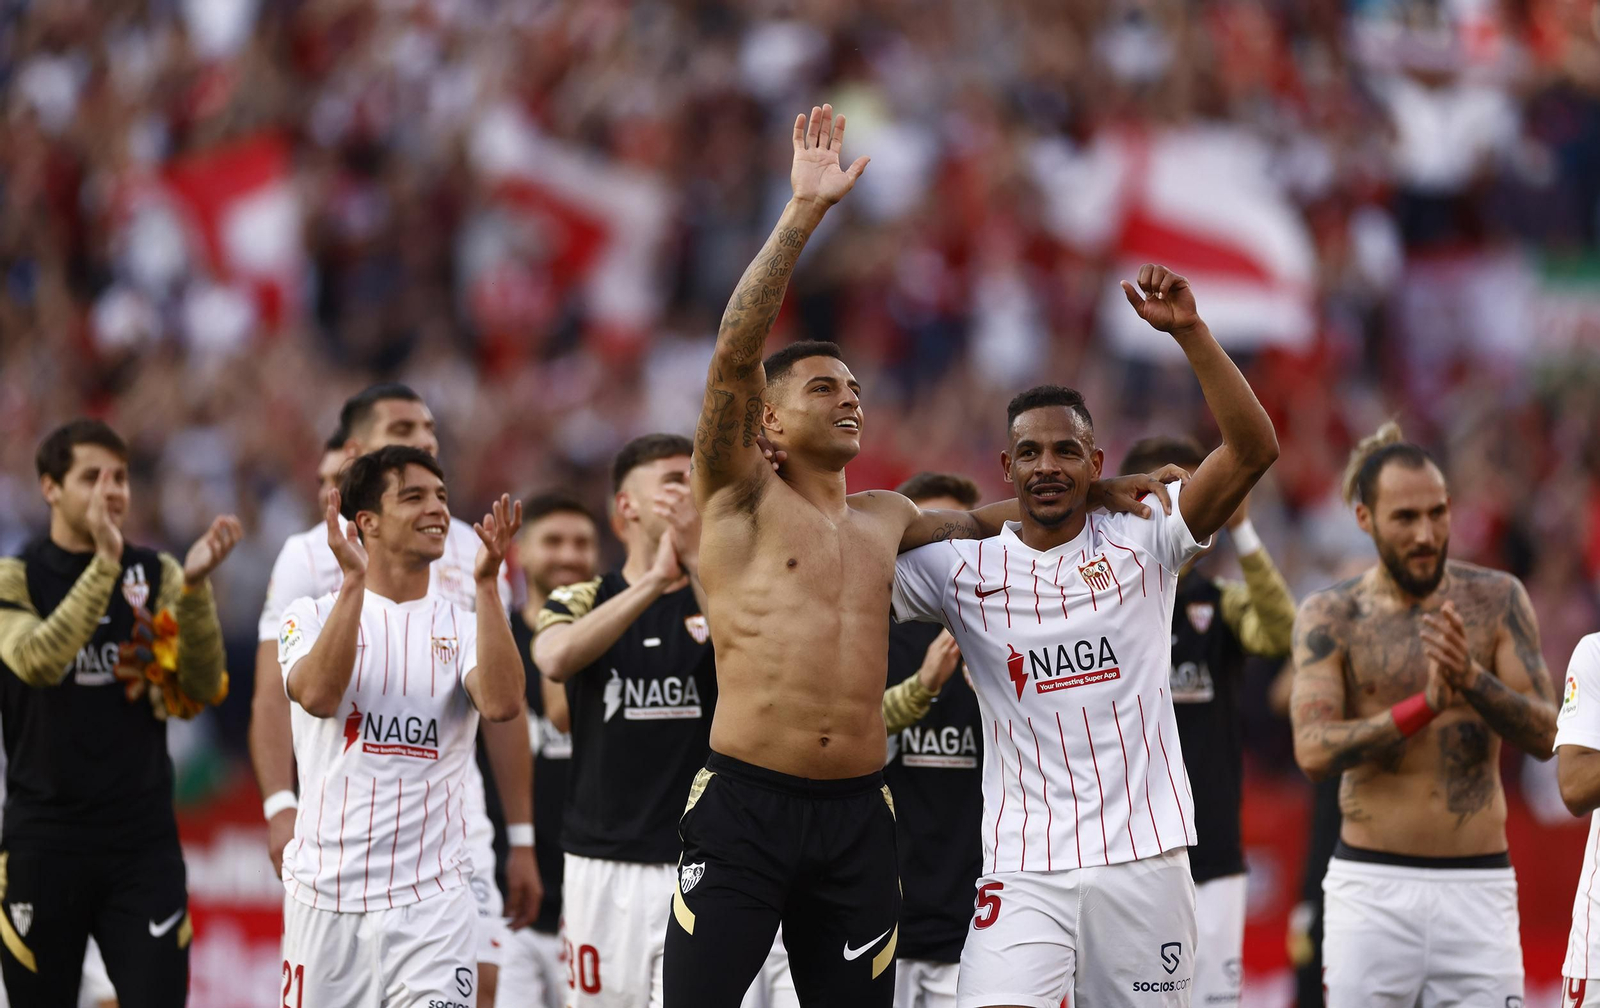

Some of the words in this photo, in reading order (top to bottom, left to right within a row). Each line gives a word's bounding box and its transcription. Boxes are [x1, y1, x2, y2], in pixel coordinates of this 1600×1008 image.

[76, 642, 119, 673] NAG
[1028, 636, 1118, 680] NAGA
[624, 675, 700, 707] NAGA
[1055, 678, 1085, 688] Investing
[1085, 675, 1103, 683] Super
[1104, 671, 1117, 679] App
[363, 712, 438, 748] NAGA
[902, 726, 977, 755] NAGA
[974, 882, 1004, 930] 5
[282, 960, 304, 1008] 21
